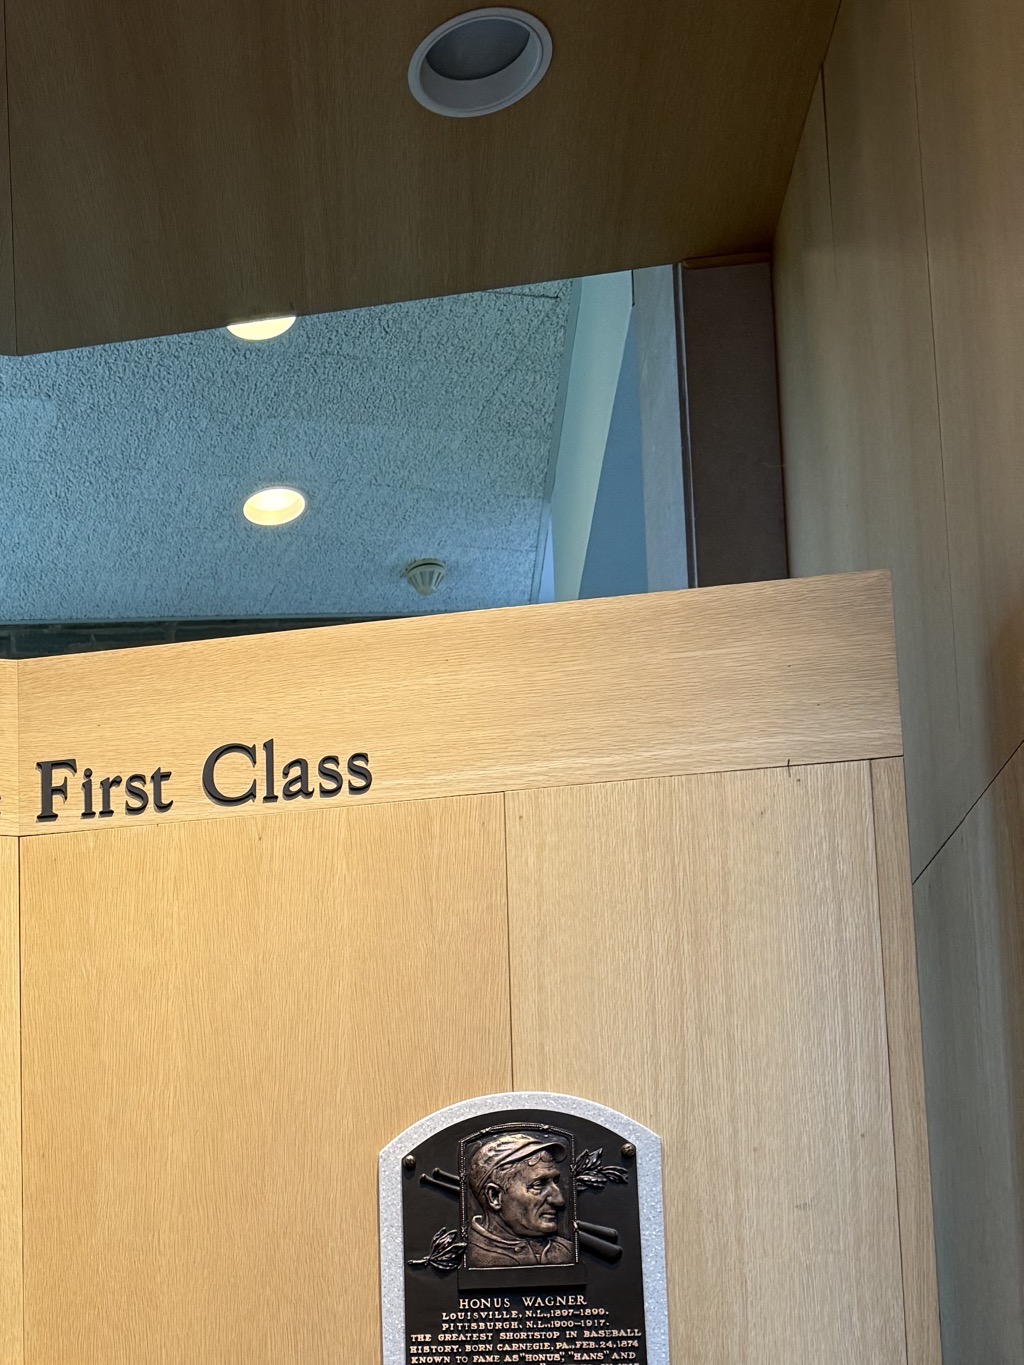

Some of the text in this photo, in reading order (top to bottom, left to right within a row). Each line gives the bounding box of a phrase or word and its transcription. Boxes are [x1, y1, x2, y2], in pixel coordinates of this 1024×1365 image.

[34, 757, 175, 823] First
[200, 737, 375, 807] Class
[459, 1295, 587, 1309] HONUS WAGNER
[438, 1333, 492, 1341] GREATEST
[584, 1329, 641, 1337] BASEBALL
